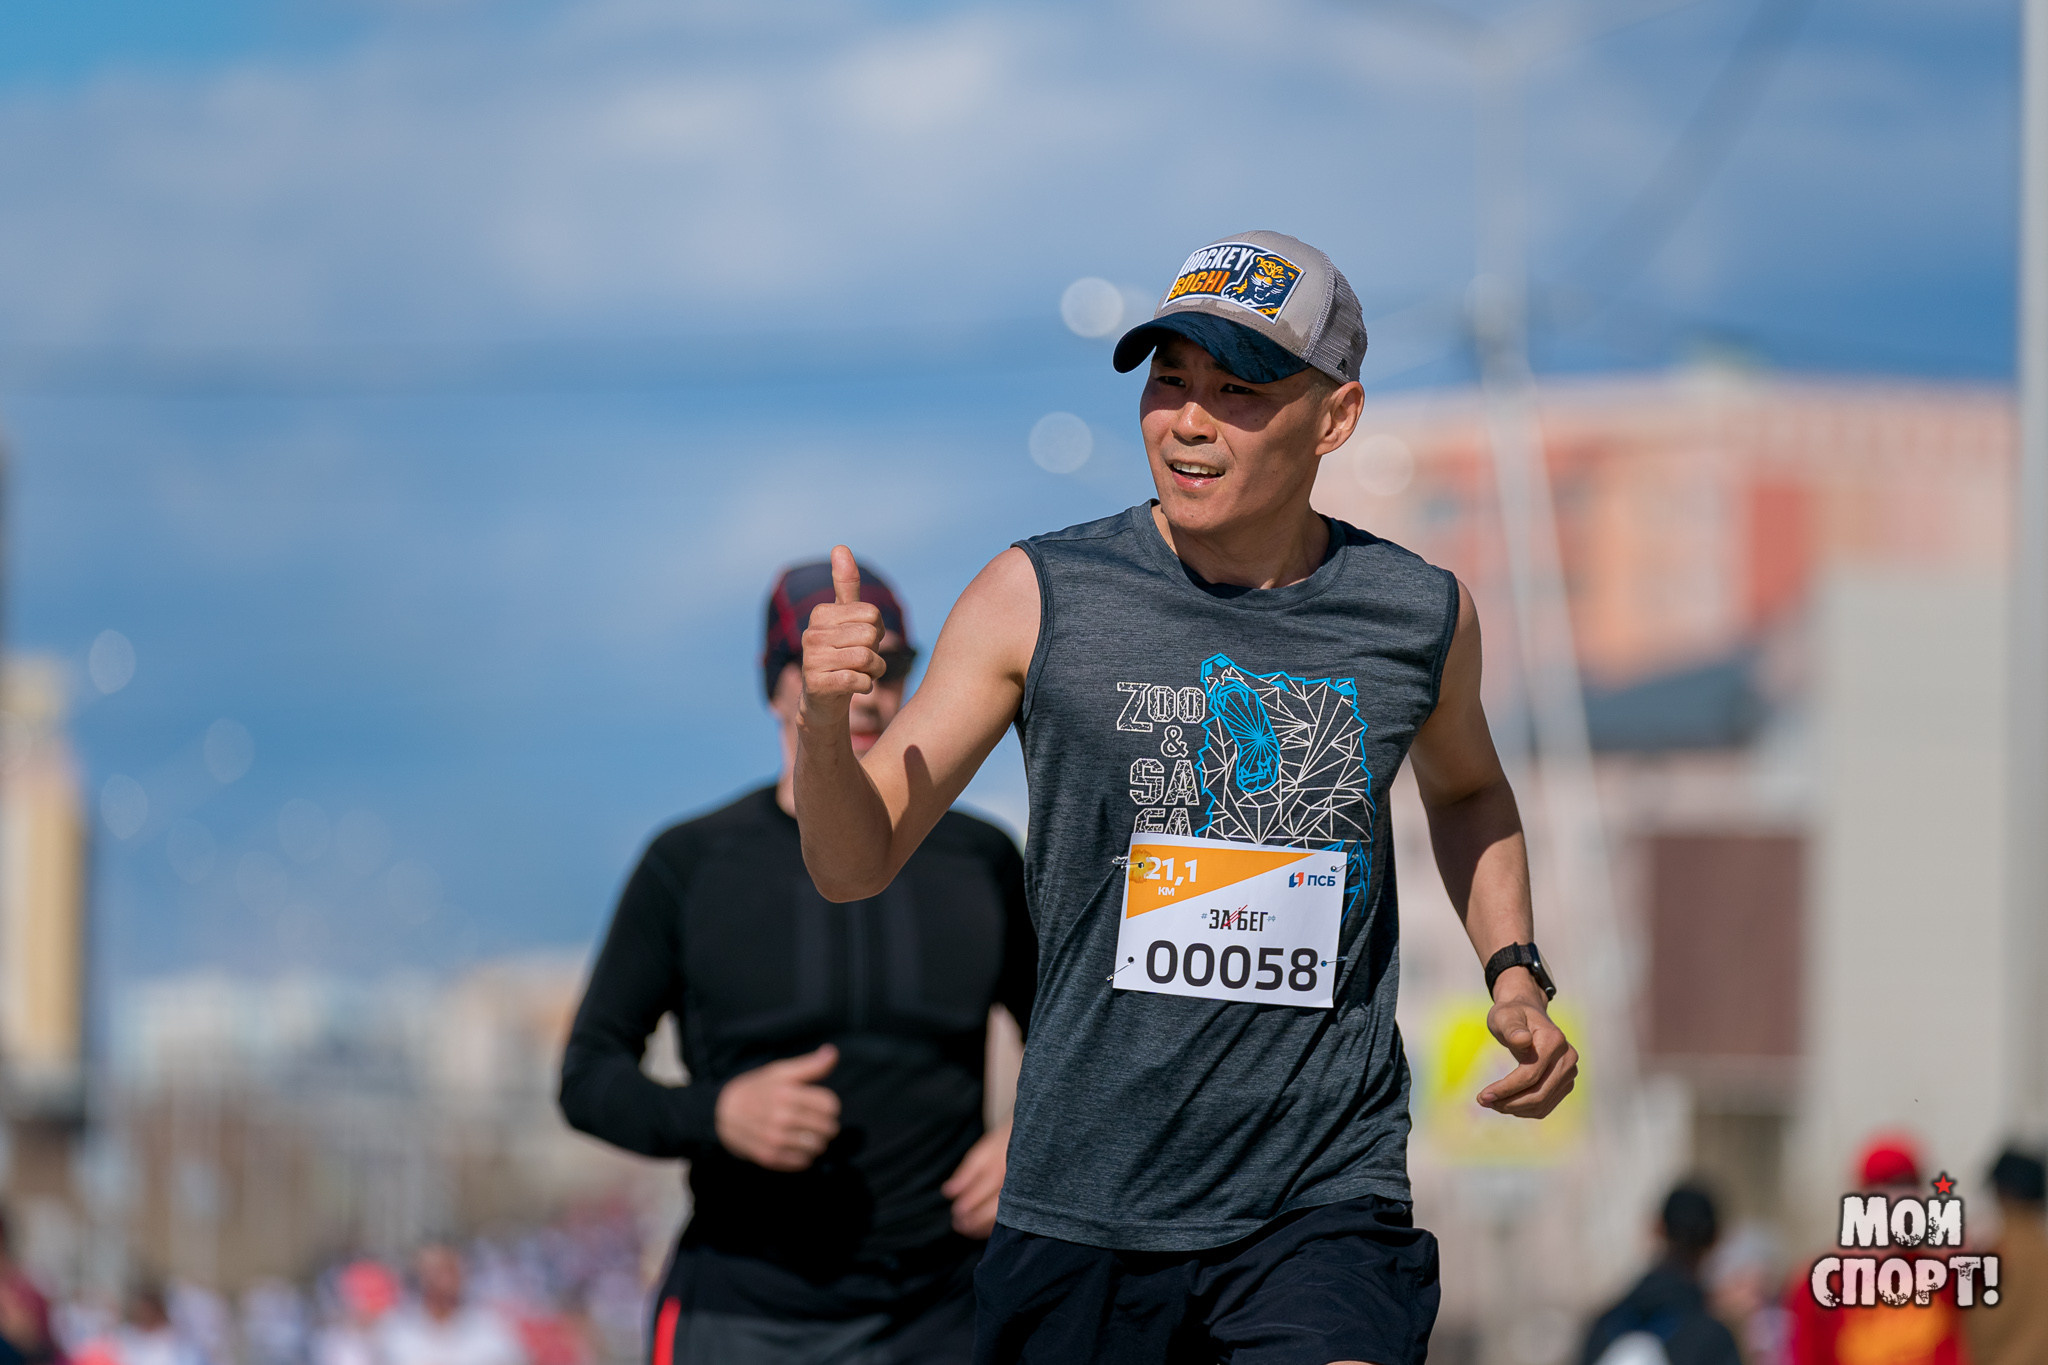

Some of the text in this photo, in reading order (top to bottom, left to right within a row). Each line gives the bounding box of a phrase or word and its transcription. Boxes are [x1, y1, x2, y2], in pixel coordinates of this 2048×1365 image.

[1179, 246, 1255, 277] HOCKEY
[1168, 270, 1231, 300] SOCHI
[1116, 681, 1206, 733] ZOO
[1160, 725, 1189, 758] &
[1129, 758, 1200, 806] SA
[1143, 856, 1198, 887] 21,1
[1307, 874, 1337, 887] ПСБ
[1146, 939, 1318, 992] 00058
